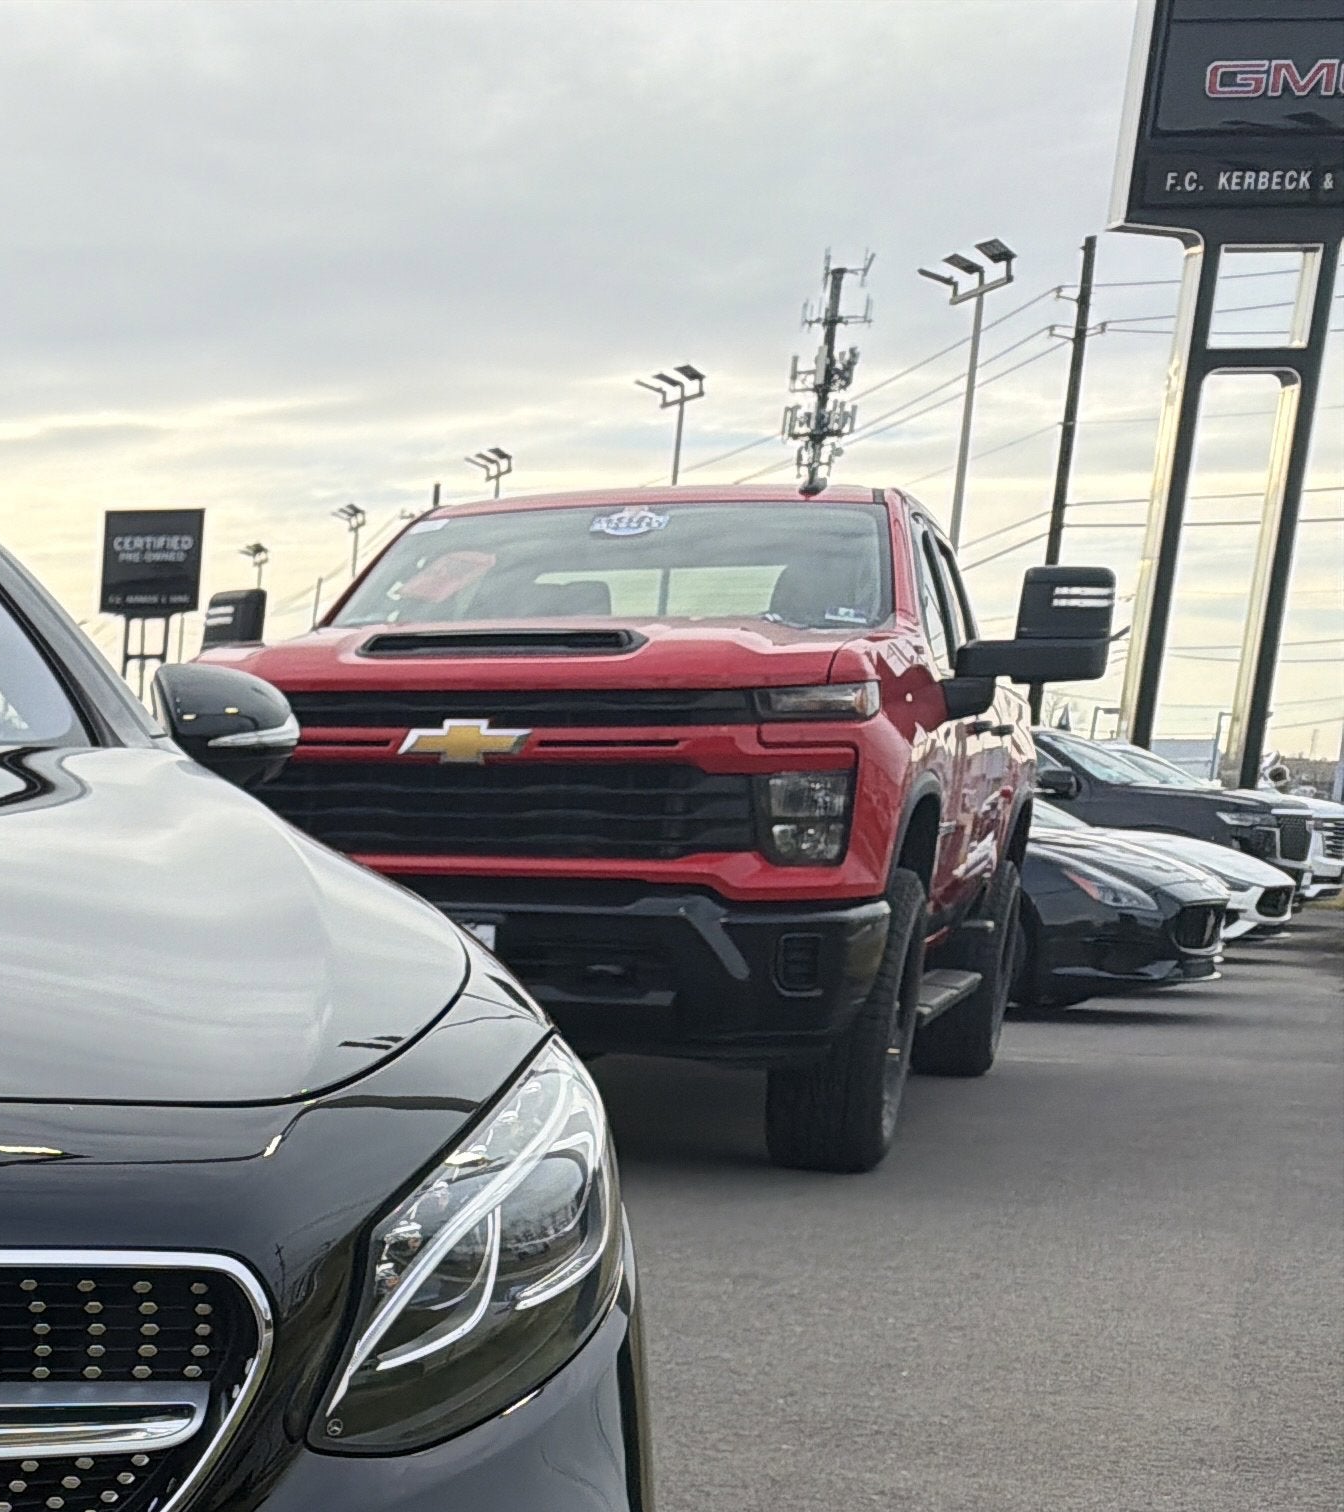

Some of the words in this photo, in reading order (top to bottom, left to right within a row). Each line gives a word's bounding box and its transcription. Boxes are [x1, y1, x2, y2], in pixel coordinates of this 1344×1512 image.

[1205, 59, 1344, 98] GM
[1165, 171, 1205, 191] F.C.
[1217, 170, 1312, 190] KERBECK
[1322, 172, 1335, 189] &
[113, 535, 194, 552] CERTIFIED
